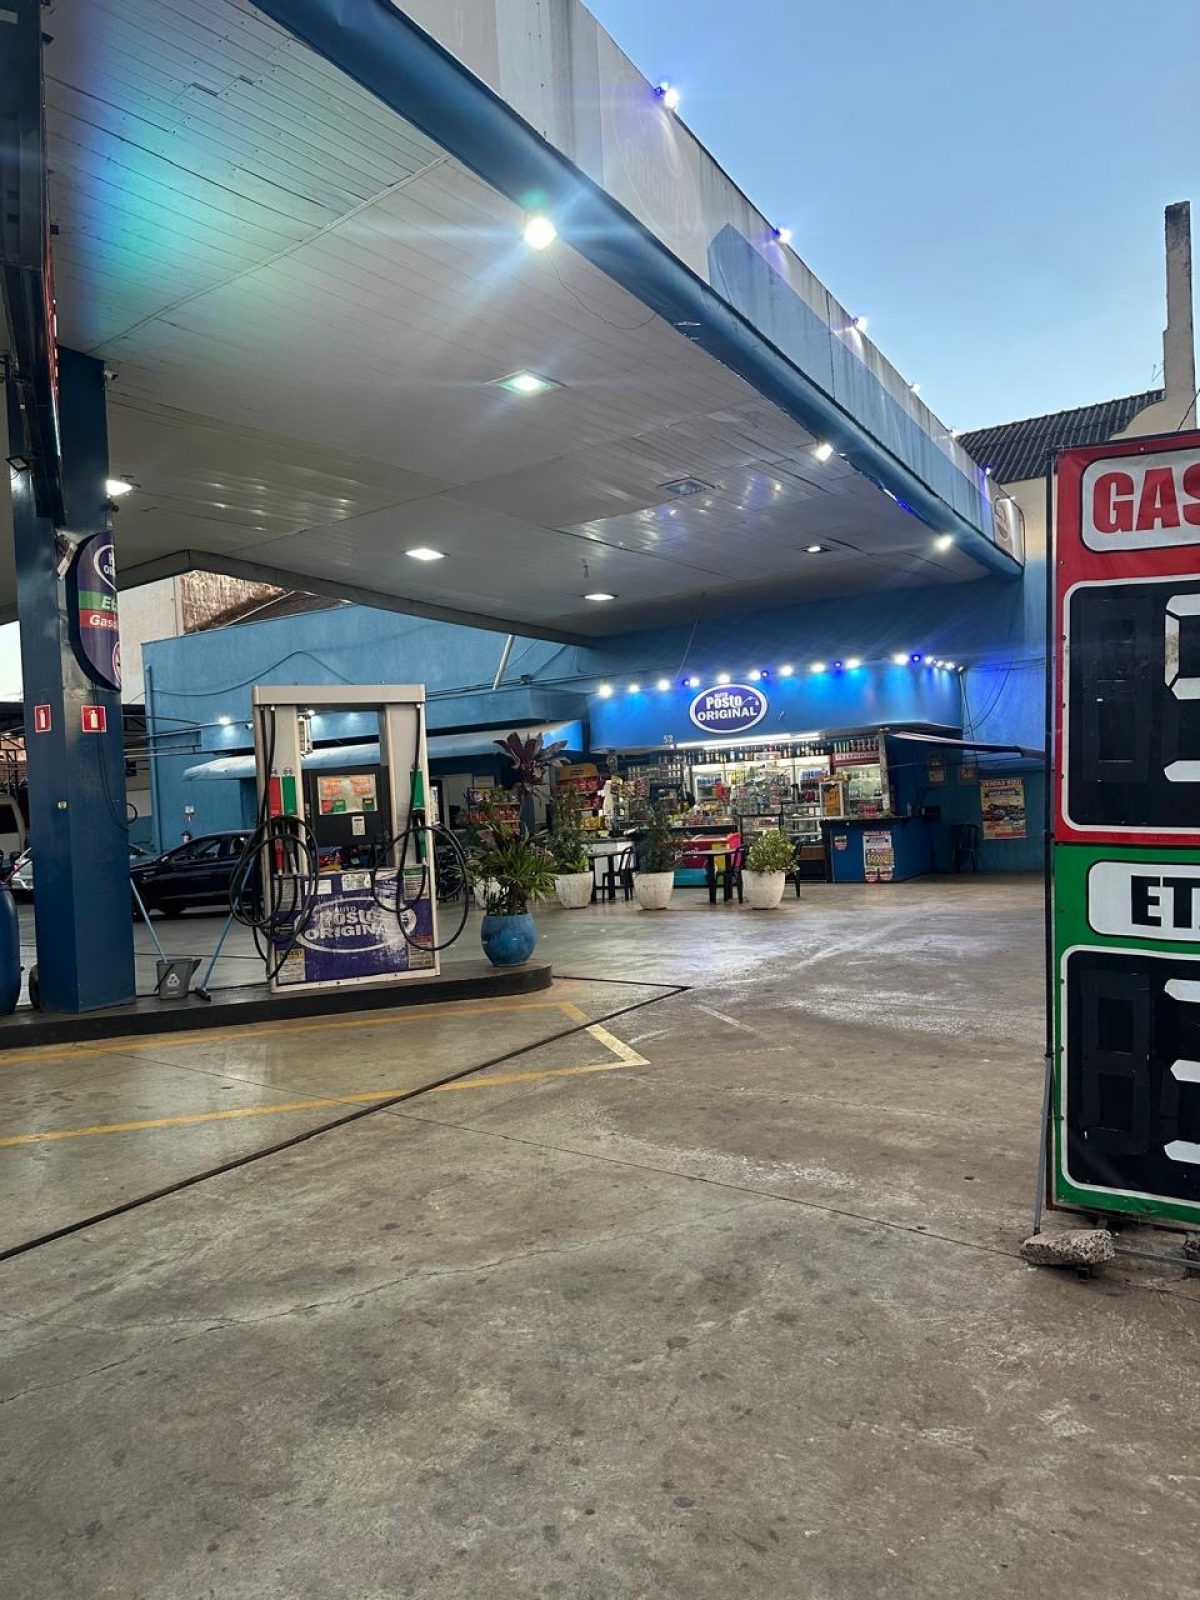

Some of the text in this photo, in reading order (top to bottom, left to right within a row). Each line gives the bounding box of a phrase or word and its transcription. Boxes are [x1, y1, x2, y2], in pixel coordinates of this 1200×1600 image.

[101, 595, 118, 611] Et
[697, 706, 758, 721] ORIGINAL
[1130, 874, 1200, 930] ET
[304, 924, 386, 941] ORIGINA
